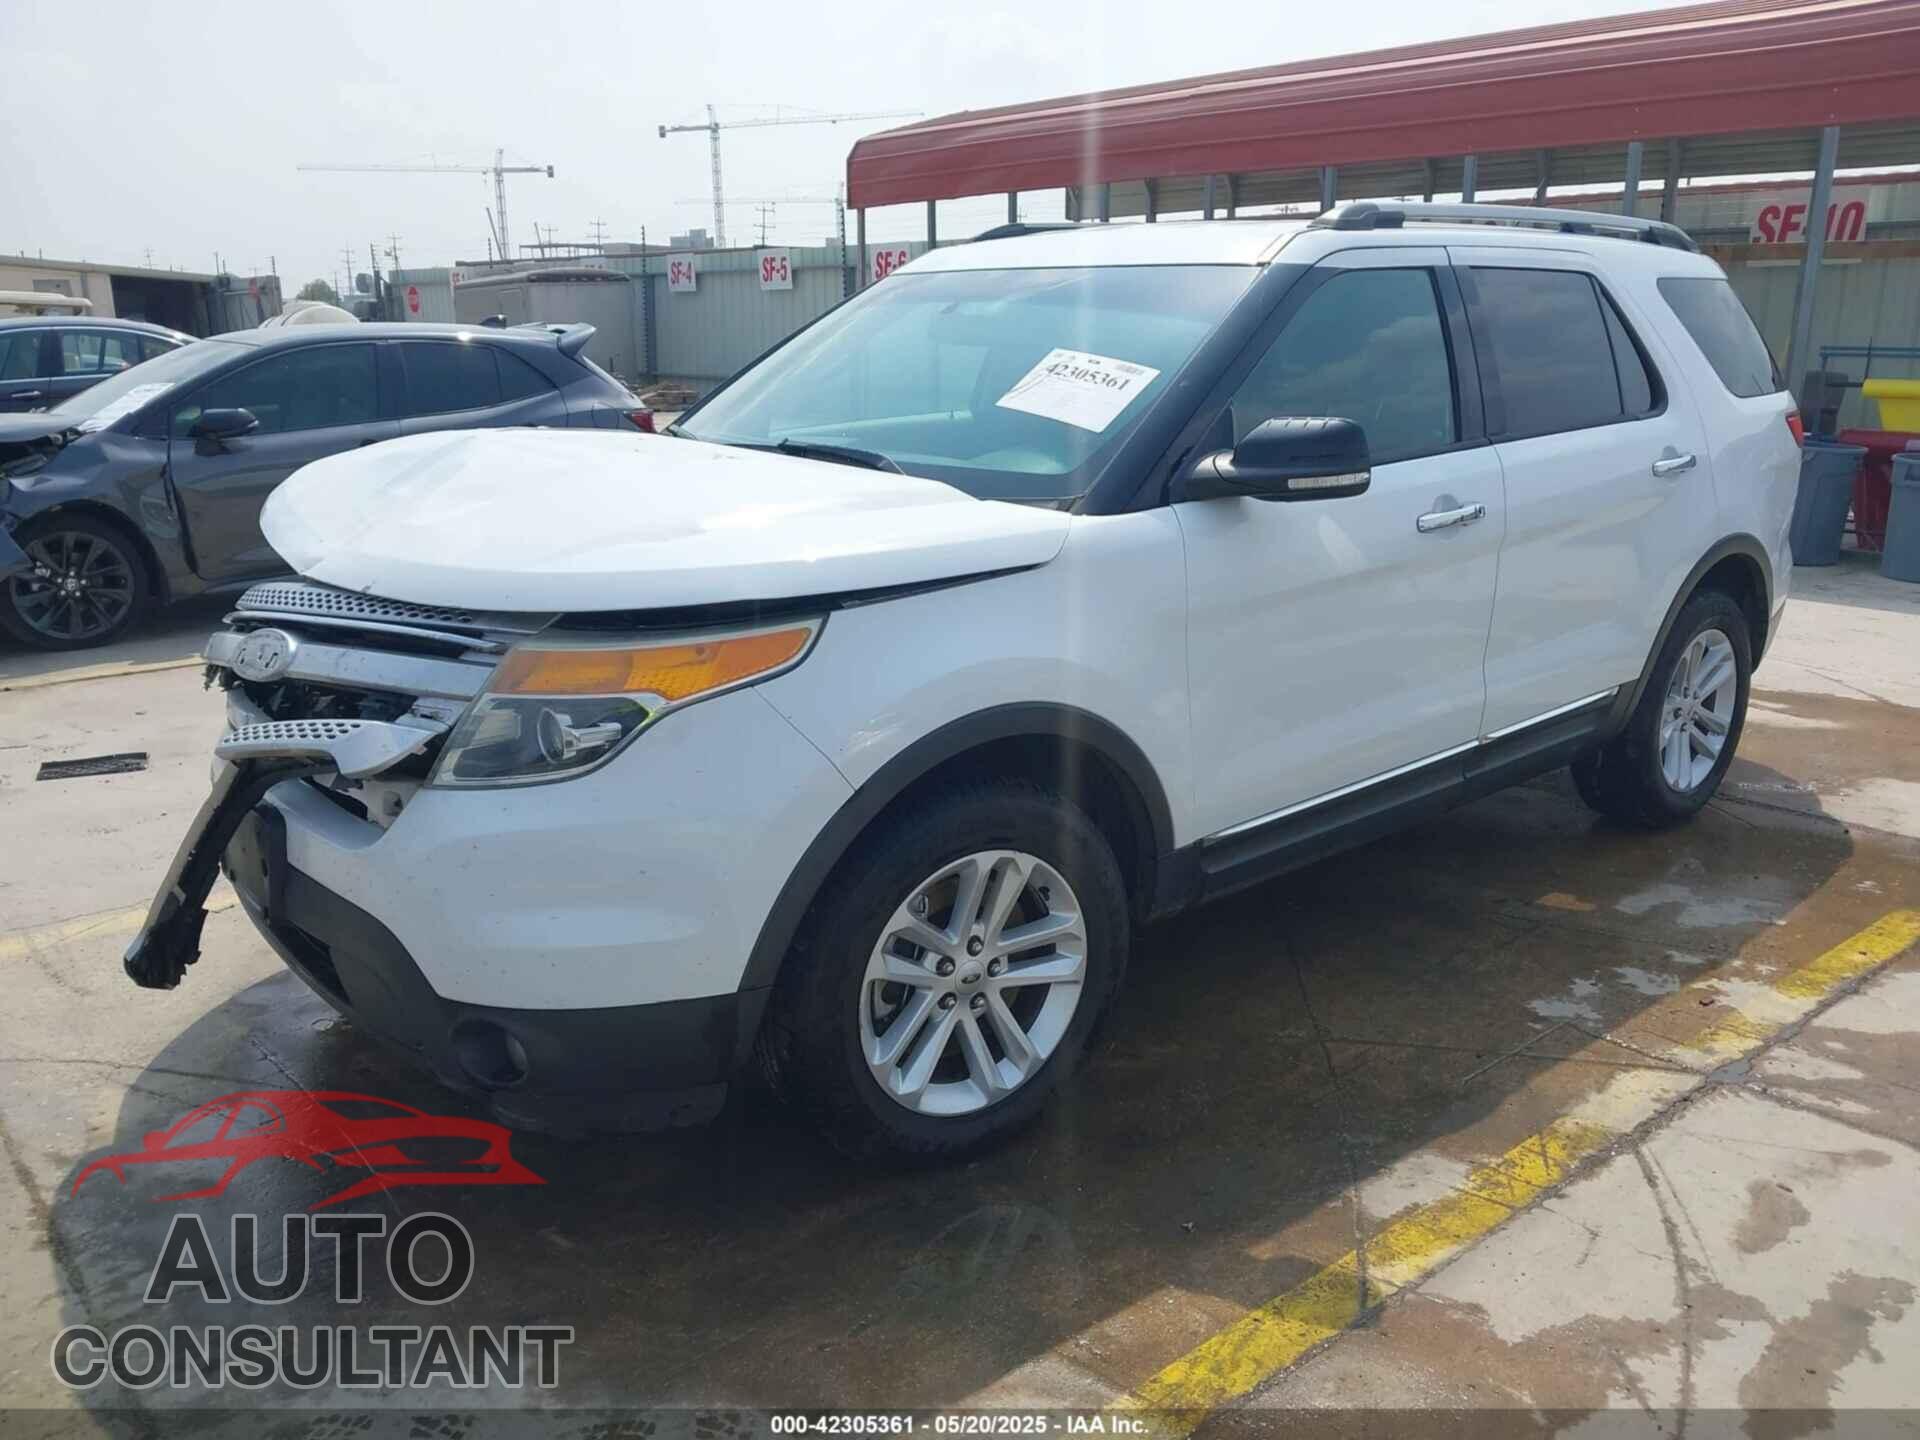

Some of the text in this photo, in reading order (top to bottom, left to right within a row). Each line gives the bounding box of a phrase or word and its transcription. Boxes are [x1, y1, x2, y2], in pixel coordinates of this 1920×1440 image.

[1751, 200, 1866, 243] SF10
[671, 261, 692, 285] SF-4
[762, 256, 788, 282] SF-5
[1046, 362, 1131, 391] 42305361
